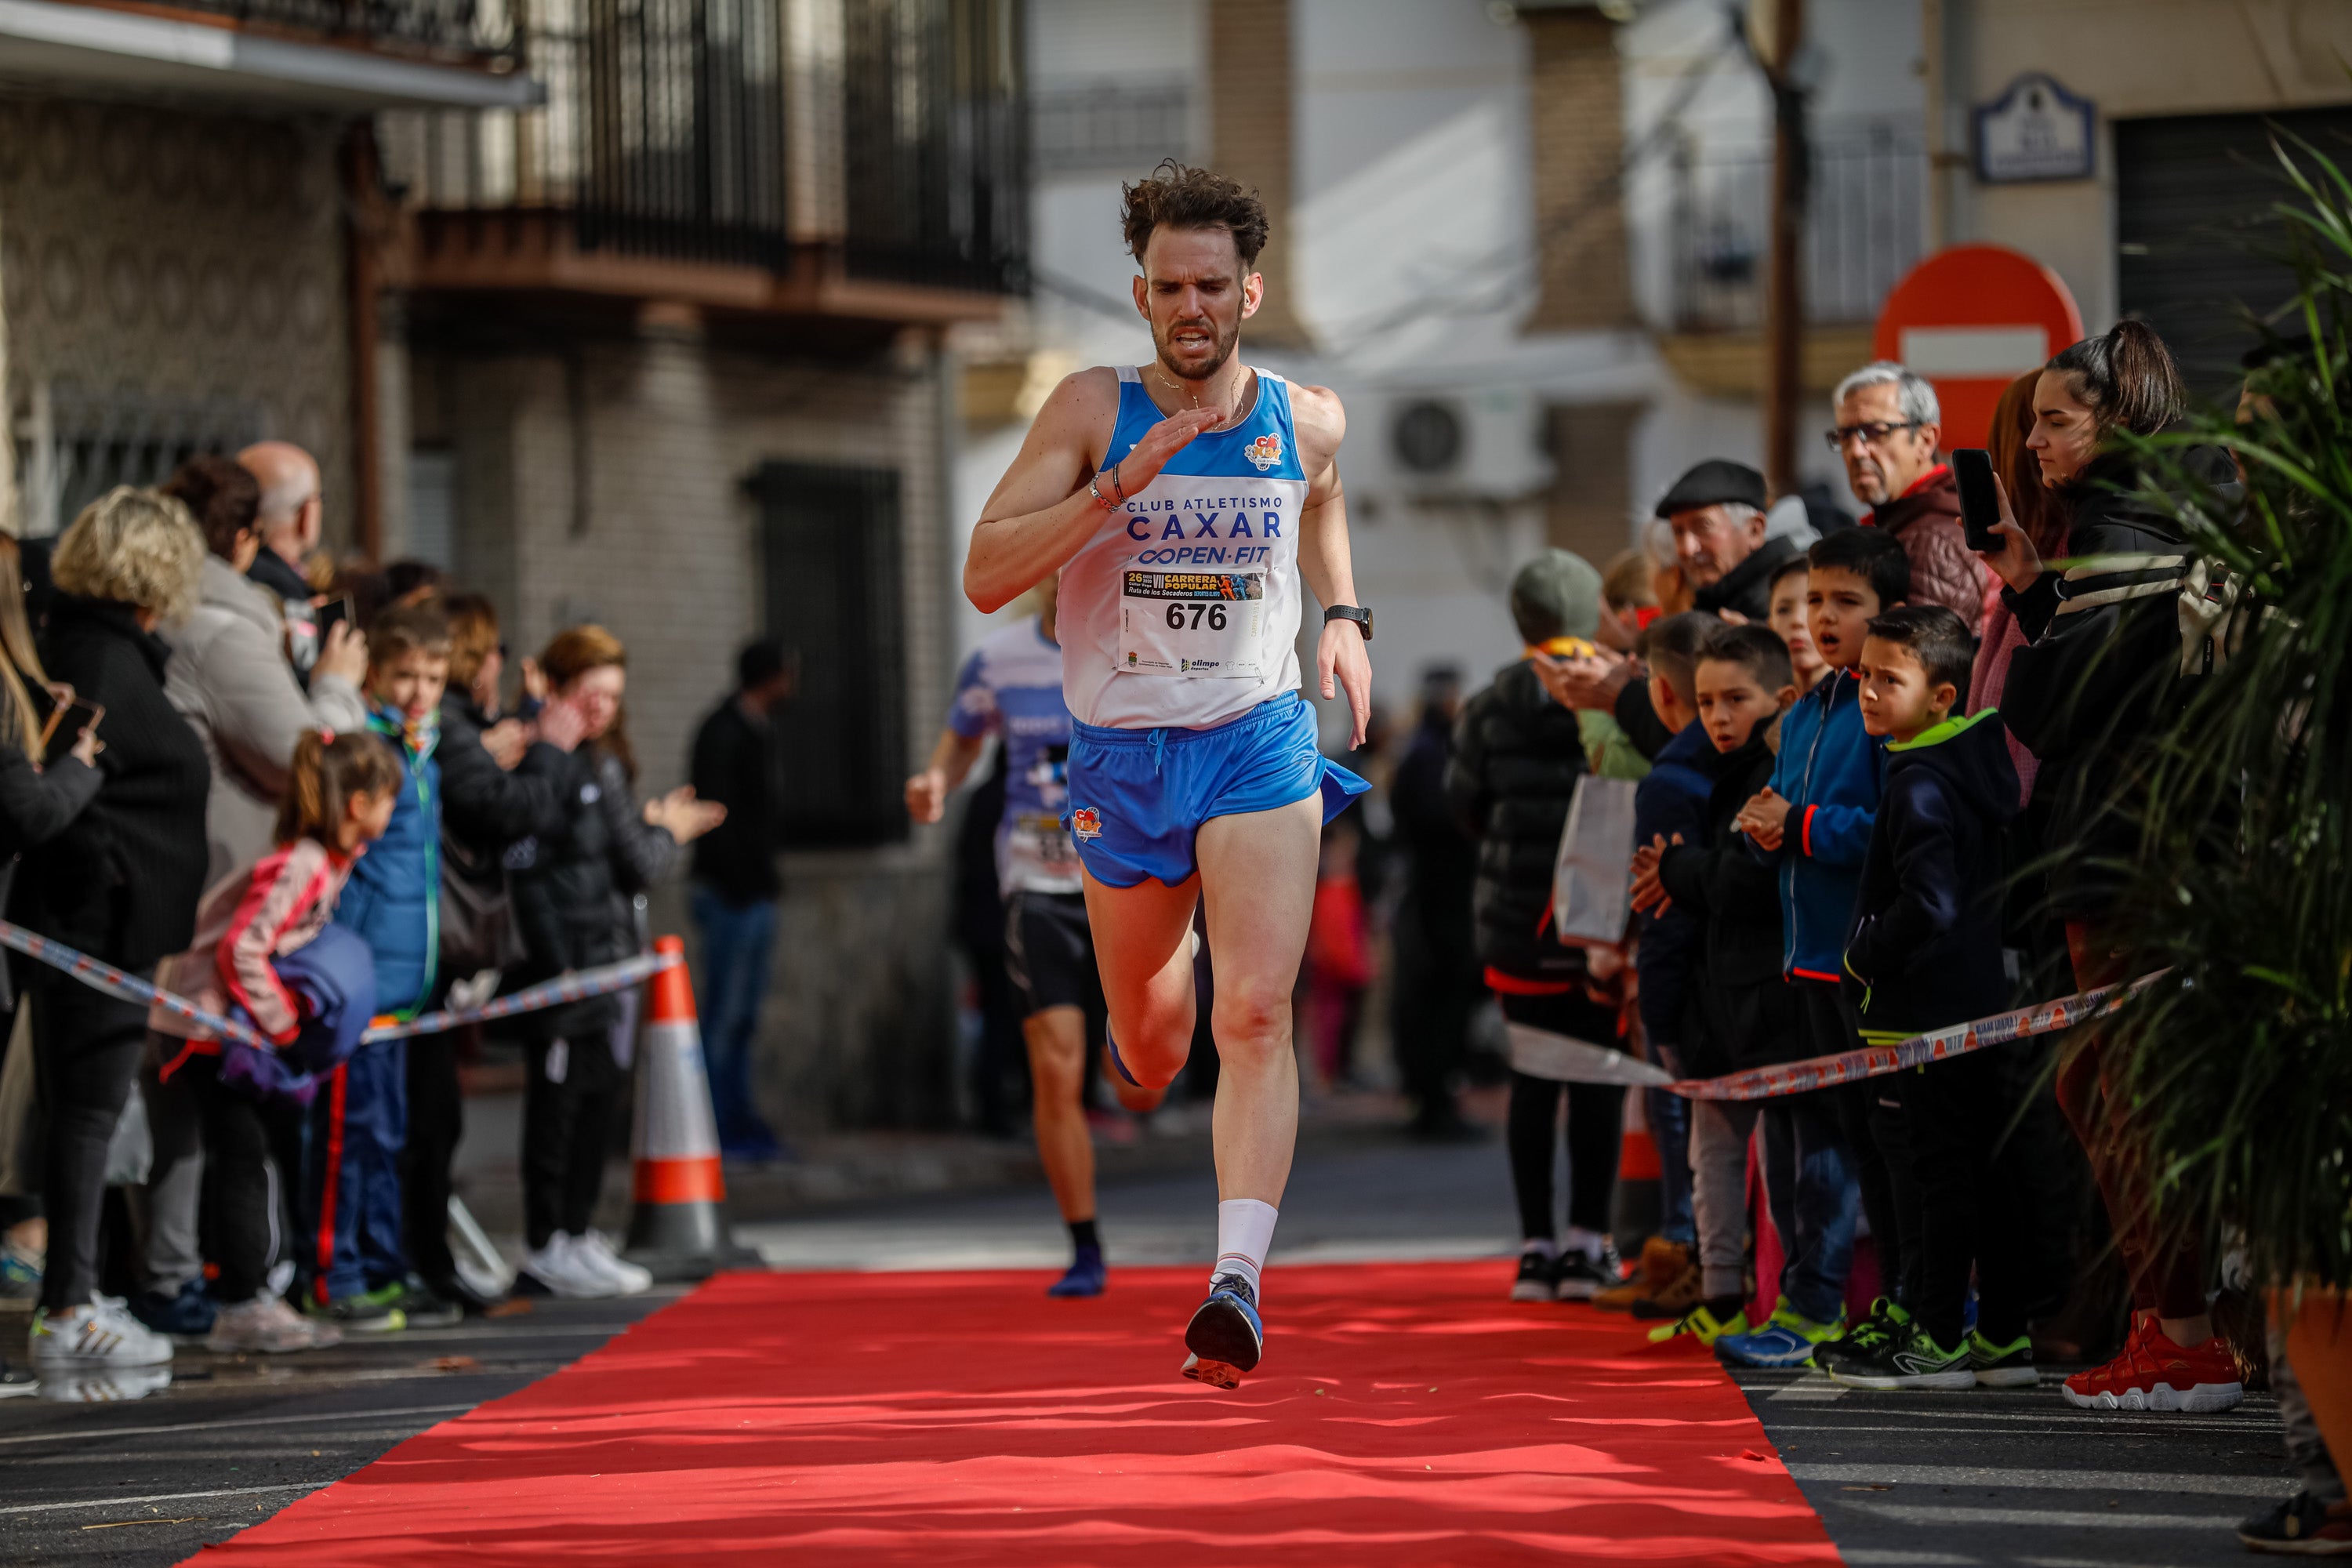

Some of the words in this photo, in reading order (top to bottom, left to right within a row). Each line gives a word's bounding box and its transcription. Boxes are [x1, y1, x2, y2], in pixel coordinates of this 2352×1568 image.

[1127, 499, 1174, 513] CLUB
[1183, 497, 1283, 509] ATLETISMO
[1127, 512, 1281, 541] CAXAR
[1129, 573, 1142, 583] 26
[1153, 574, 1164, 589] VII
[1165, 575, 1217, 583] CARRERA
[1166, 603, 1227, 630] 676
[1192, 659, 1219, 668] olimpo
